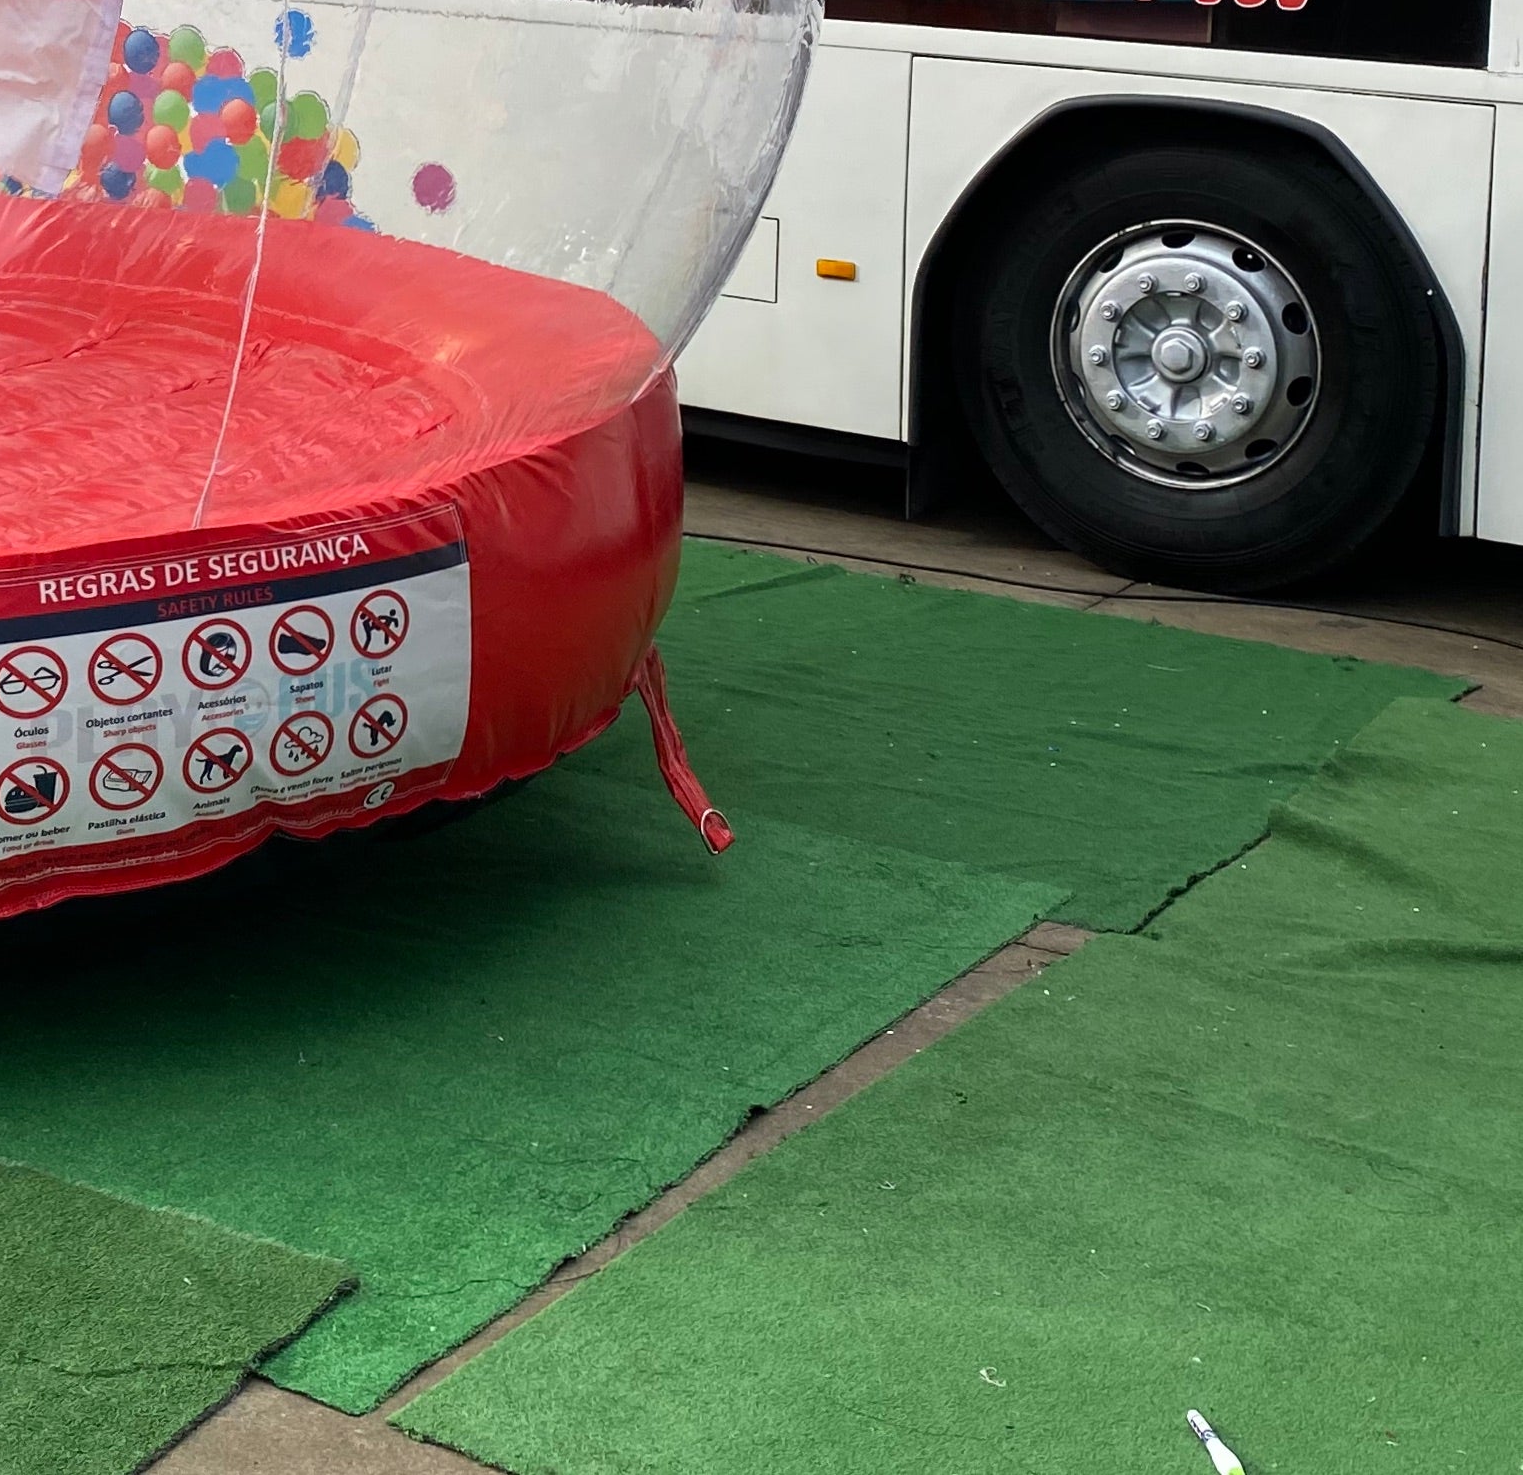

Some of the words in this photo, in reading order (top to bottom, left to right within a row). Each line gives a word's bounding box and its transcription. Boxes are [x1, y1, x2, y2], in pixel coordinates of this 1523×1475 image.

[38, 567, 156, 605] REGRAS
[165, 560, 201, 588] DE
[208, 534, 370, 579] SEGURANÇA
[157, 594, 219, 619] SAFETY
[223, 584, 274, 608] RULES
[371, 664, 393, 677] Lutar
[289, 680, 324, 694] Sapatos
[197, 694, 247, 711] Acessórios
[85, 714, 125, 729] Objetos
[127, 708, 174, 722] cortantes
[14, 725, 50, 739] Óculos
[88, 816, 127, 830] Pastilha
[129, 811, 166, 824] elástica
[41, 826, 71, 837] beber
